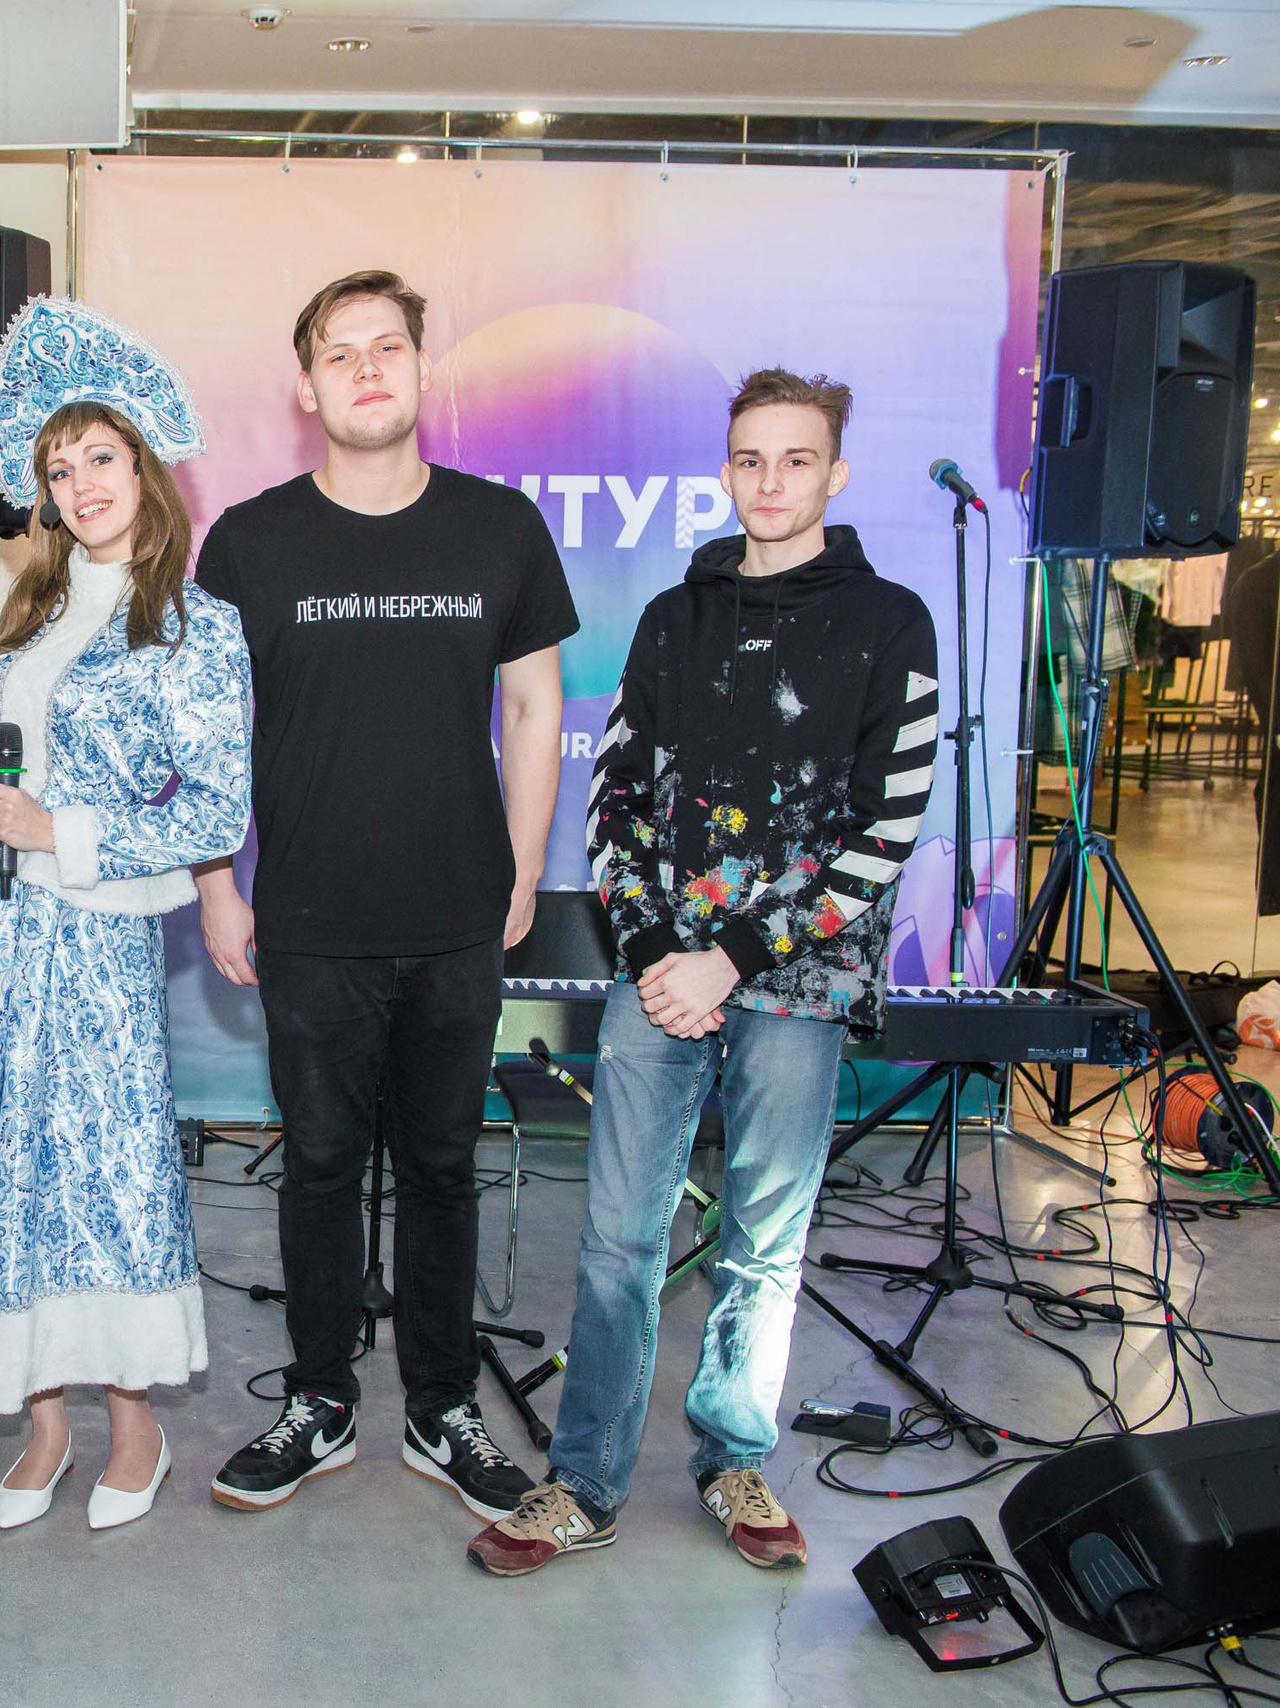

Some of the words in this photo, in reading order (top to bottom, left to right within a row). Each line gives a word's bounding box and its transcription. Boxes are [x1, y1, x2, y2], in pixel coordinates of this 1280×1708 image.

[296, 593, 361, 623] ЛЁГКИЙ
[364, 596, 376, 618] И
[379, 593, 483, 618] НЕБРЕЖНЫЙ
[745, 639, 773, 651] OFF
